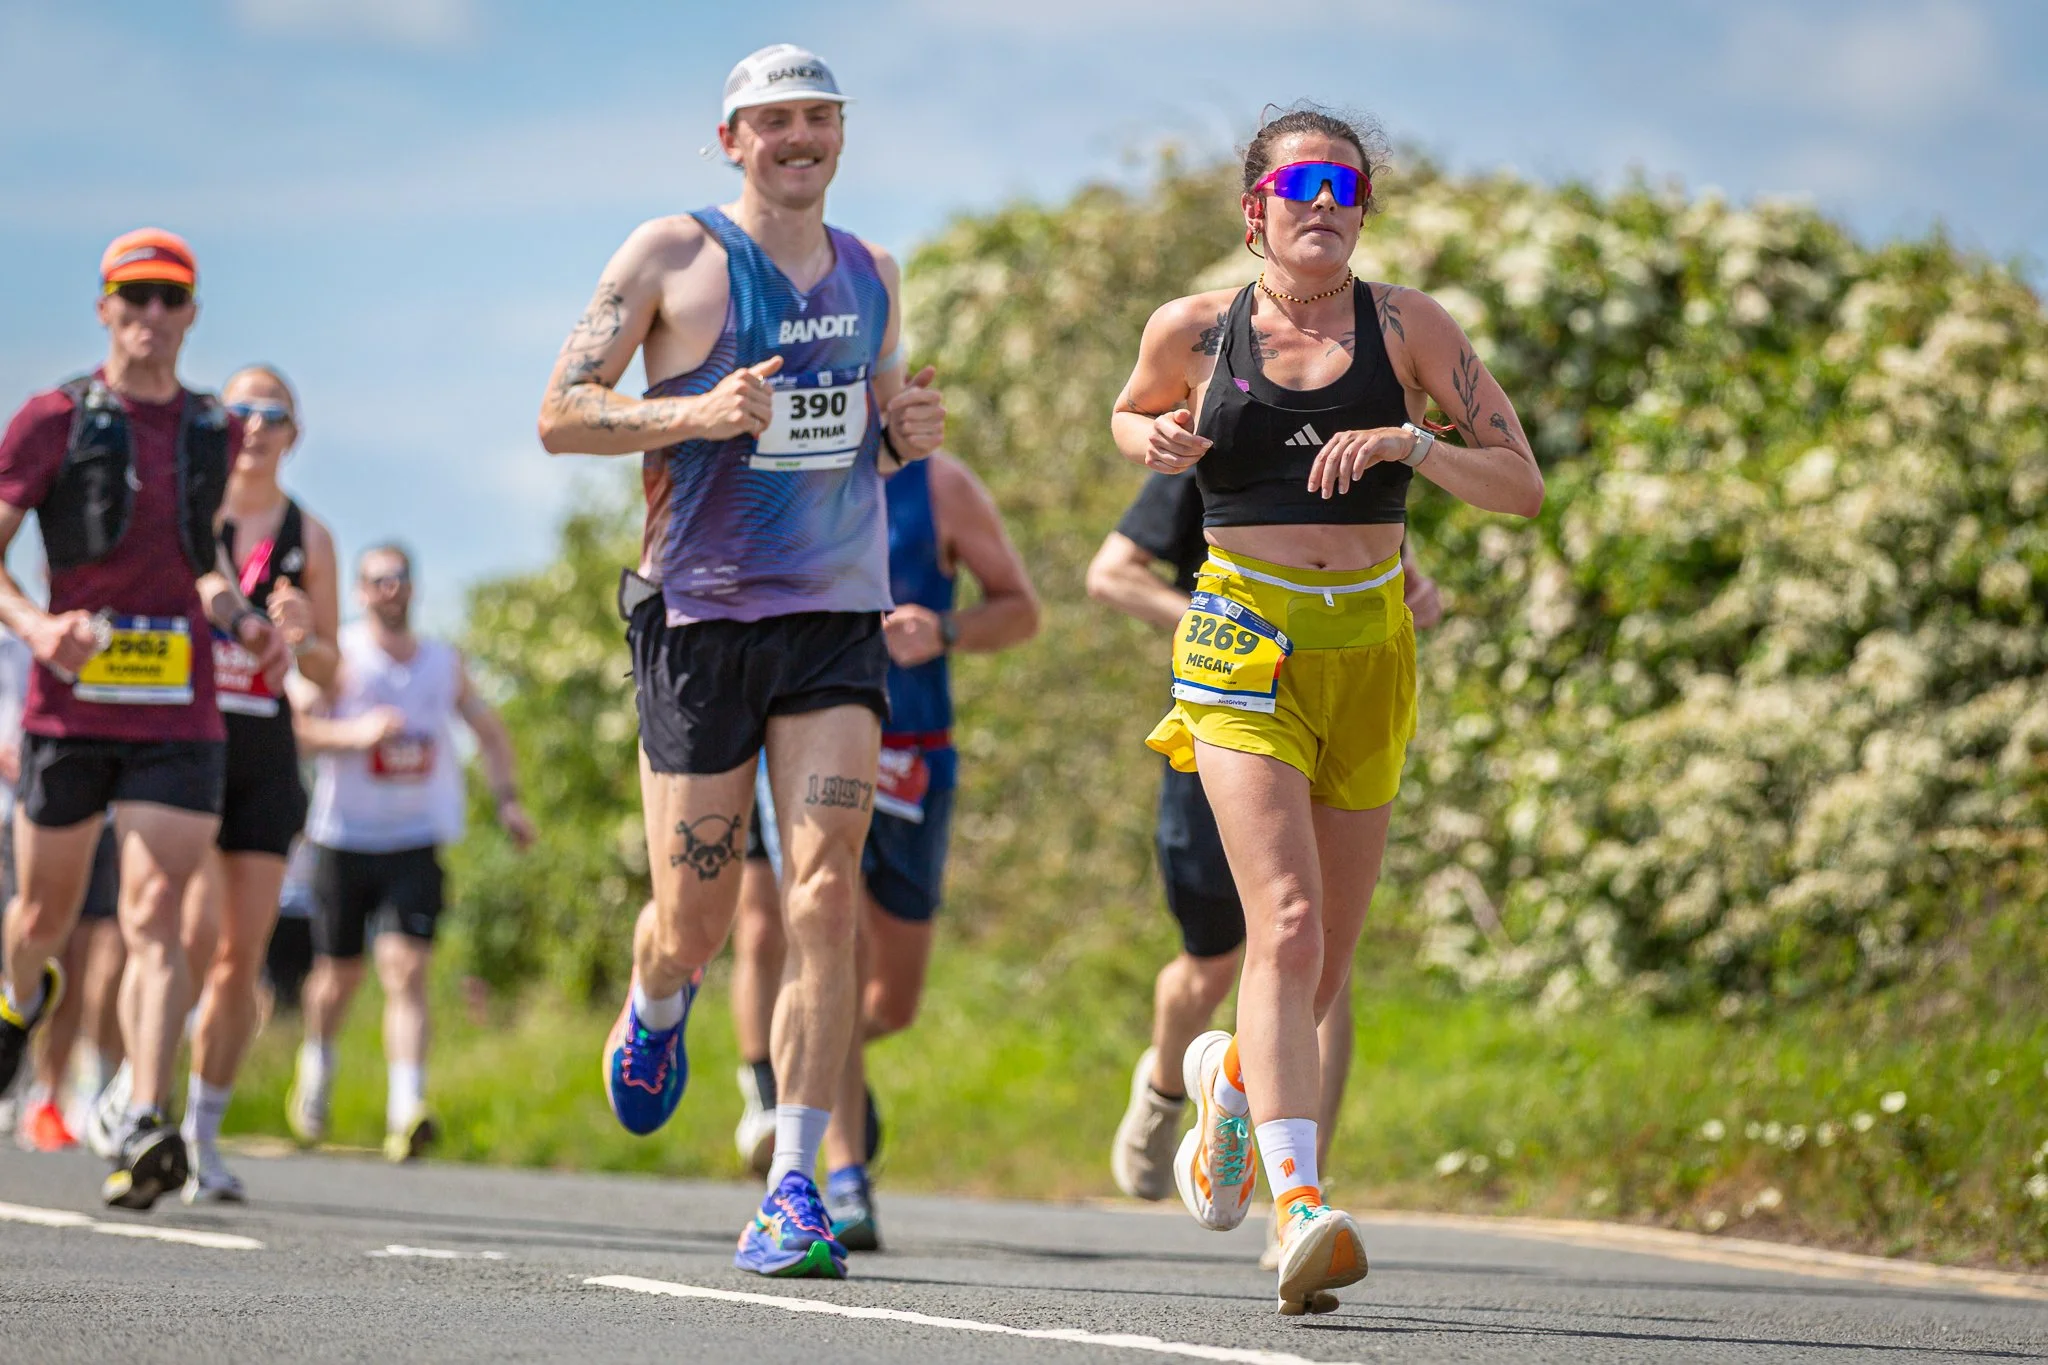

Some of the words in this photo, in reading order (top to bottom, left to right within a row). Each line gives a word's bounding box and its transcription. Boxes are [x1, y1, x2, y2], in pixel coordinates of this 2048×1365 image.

[789, 391, 847, 420] 390
[788, 423, 846, 441] NATHAN
[1185, 614, 1260, 655] 3269
[1185, 652, 1235, 675] MEGAN
[1217, 699, 1247, 707] JustGiving
